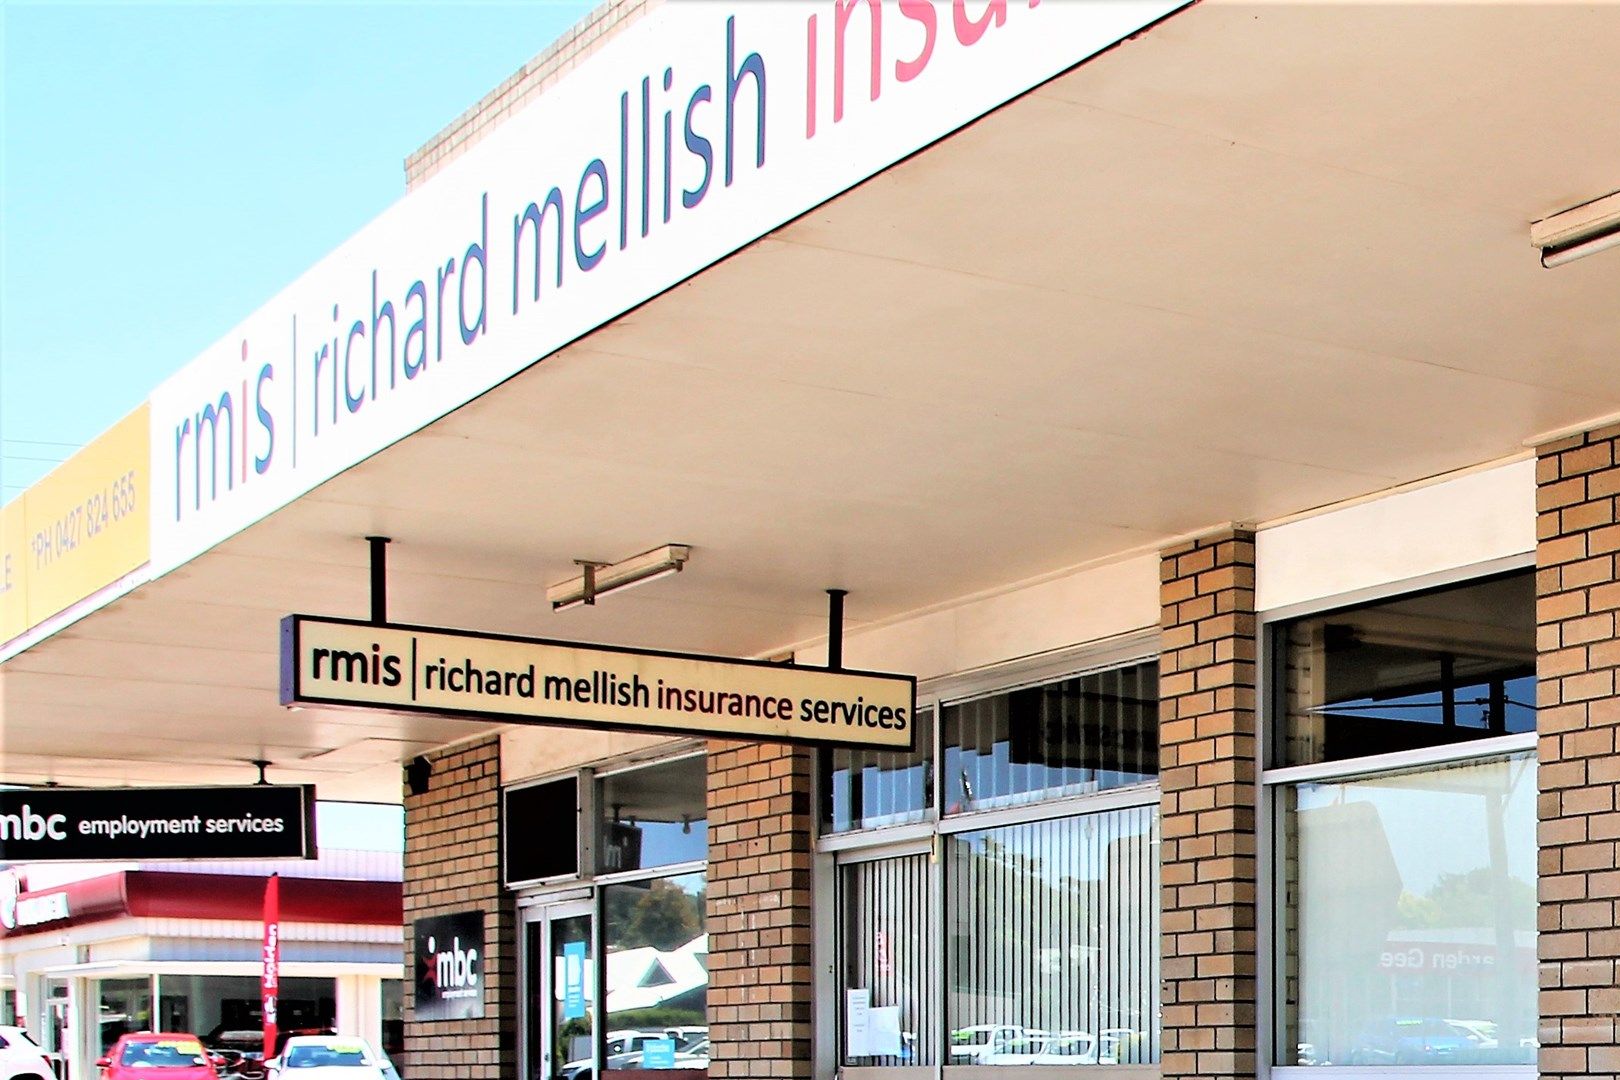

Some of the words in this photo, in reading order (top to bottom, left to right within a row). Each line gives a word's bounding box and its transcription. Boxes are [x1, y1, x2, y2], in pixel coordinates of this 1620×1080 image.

[175, 338, 275, 522] rmis
[313, 191, 488, 437] richard
[512, 14, 767, 316] mellish
[56, 505, 82, 558] 0427
[86, 487, 108, 538] 824
[112, 470, 135, 522] 655
[312, 643, 401, 686] rmis
[425, 658, 535, 698] richard
[544, 670, 650, 708] mellish
[657, 679, 793, 720] insurance
[800, 696, 907, 730] services
[78, 815, 201, 839] employment
[205, 813, 285, 833] services
[436, 936, 478, 988] mbc
